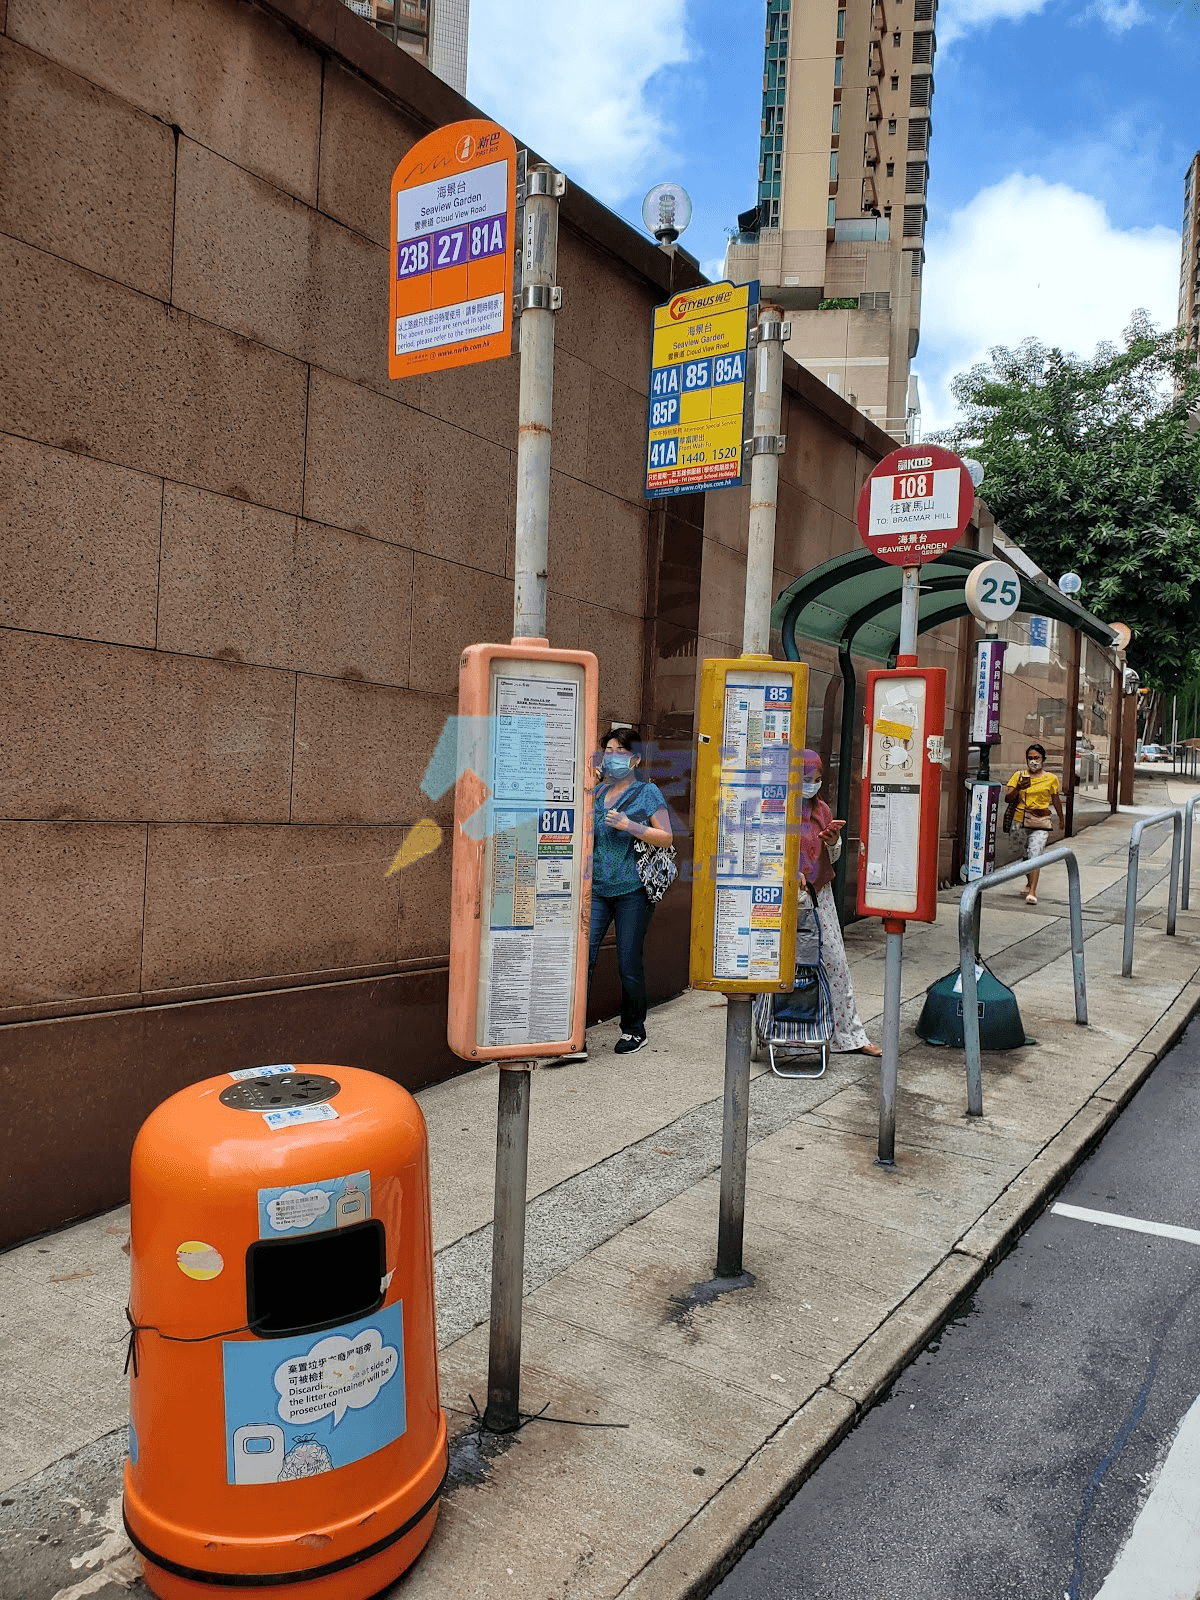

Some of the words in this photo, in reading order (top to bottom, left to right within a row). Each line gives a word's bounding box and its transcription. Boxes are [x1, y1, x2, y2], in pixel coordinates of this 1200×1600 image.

[478, 132, 500, 149] 新巴
[437, 180, 466, 200] 海景台
[421, 201, 452, 216] Seaview
[453, 193, 482, 208] Garden
[436, 213, 454, 225] Cloud
[455, 210, 469, 219] View
[470, 204, 487, 215] Road
[400, 241, 429, 275] 23B
[437, 232, 463, 265] 27
[471, 220, 503, 255] 81A
[678, 295, 715, 312] CITYBUS
[716, 291, 733, 302] 城巴
[398, 333, 407, 341] The
[408, 329, 424, 339] above
[424, 326, 441, 335] routes
[452, 317, 470, 328] served
[477, 310, 502, 323] specified
[687, 322, 712, 337] 海景台
[416, 337, 433, 348] please
[433, 333, 446, 342] refer
[454, 329, 464, 337] the
[673, 338, 700, 350] Seaview
[700, 333, 725, 344] Garden
[686, 347, 702, 356] Cloud
[702, 344, 715, 353] View
[715, 341, 730, 350] Road
[653, 369, 678, 395] 41A
[685, 362, 708, 388] 85
[715, 355, 742, 382] 85A
[652, 399, 677, 425] 85P
[651, 440, 677, 466] 41A
[682, 451, 708, 465] 1440,
[712, 446, 737, 460] 1520
[680, 479, 732, 492] www.citybus.com.hk
[899, 474, 927, 498] 108
[890, 499, 935, 514] 往寶馬山
[892, 514, 931, 523] BRAEMAR
[934, 512, 951, 520] HILL
[877, 545, 911, 554] SEAVIEW
[914, 542, 948, 551] GARDEN
[897, 533, 928, 544] 海景台
[981, 577, 1017, 606] 25
[769, 687, 788, 700] 85
[763, 785, 785, 798] 85A
[542, 811, 570, 832] 81A
[754, 887, 780, 903] 85P
[370, 1360, 385, 1372] side
[385, 1354, 393, 1364] of
[289, 1397, 304, 1406] the
[306, 1392, 327, 1403] litter
[328, 1378, 366, 1397] container
[367, 1371, 380, 1383] will
[381, 1367, 390, 1377] be
[289, 1382, 333, 1396] Discardi
[289, 1398, 337, 1419] prosecuted
